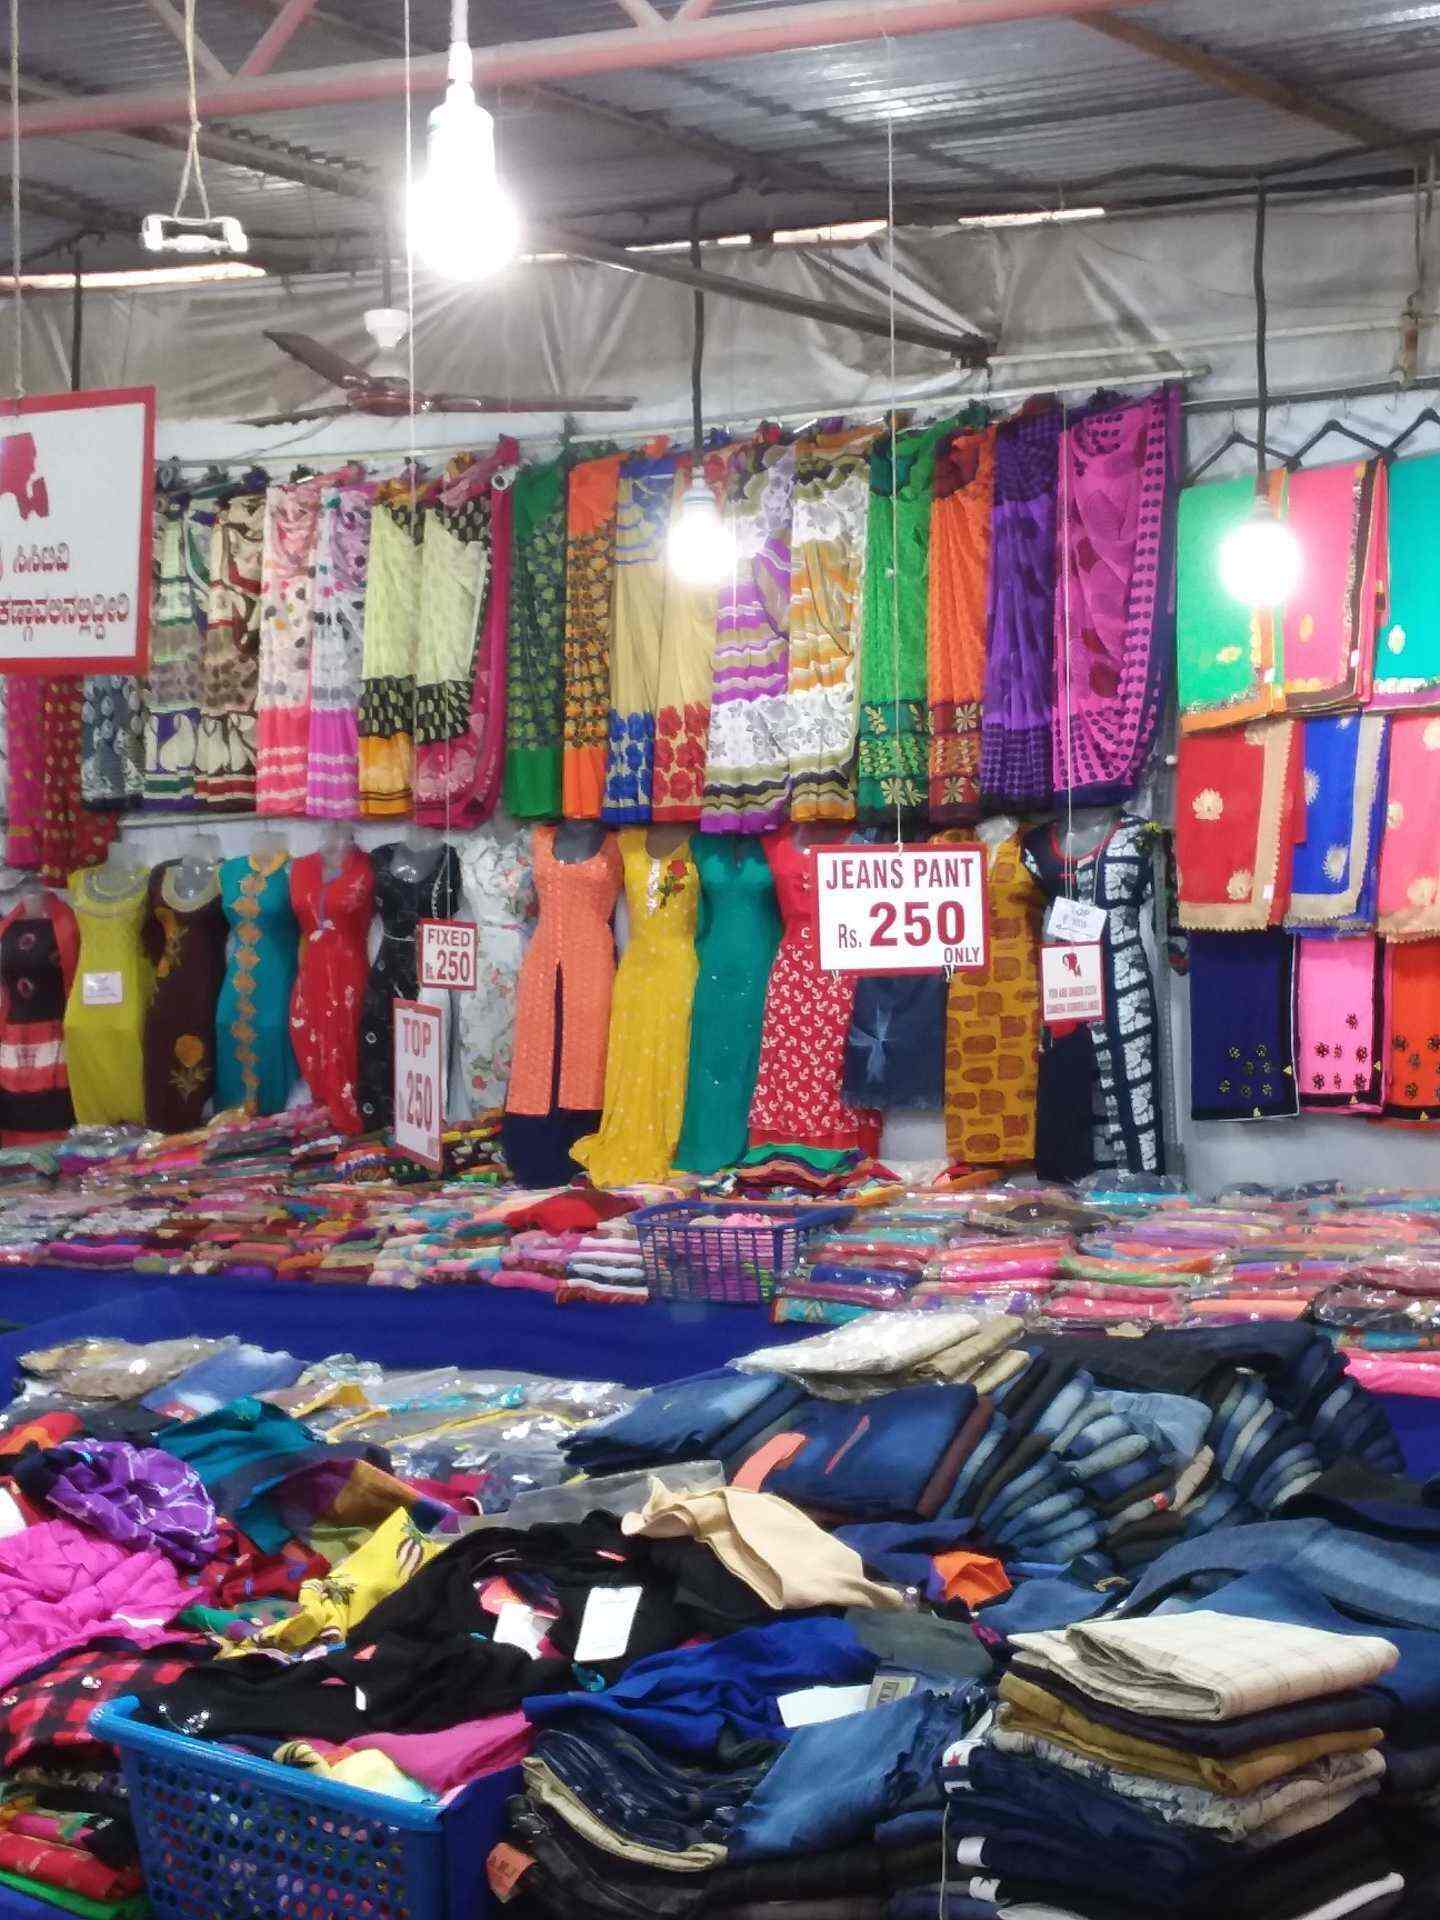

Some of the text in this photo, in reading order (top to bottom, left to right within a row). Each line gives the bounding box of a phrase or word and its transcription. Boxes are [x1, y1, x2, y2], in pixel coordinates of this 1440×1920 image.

[826, 857, 974, 890] JEANS PANT
[427, 928, 470, 947] FIXED
[838, 901, 965, 949] Rs. 250
[436, 949, 470, 982] 250
[943, 948, 980, 963] ONLY
[402, 1017, 432, 1058] TOP
[406, 1070, 433, 1132] 250
